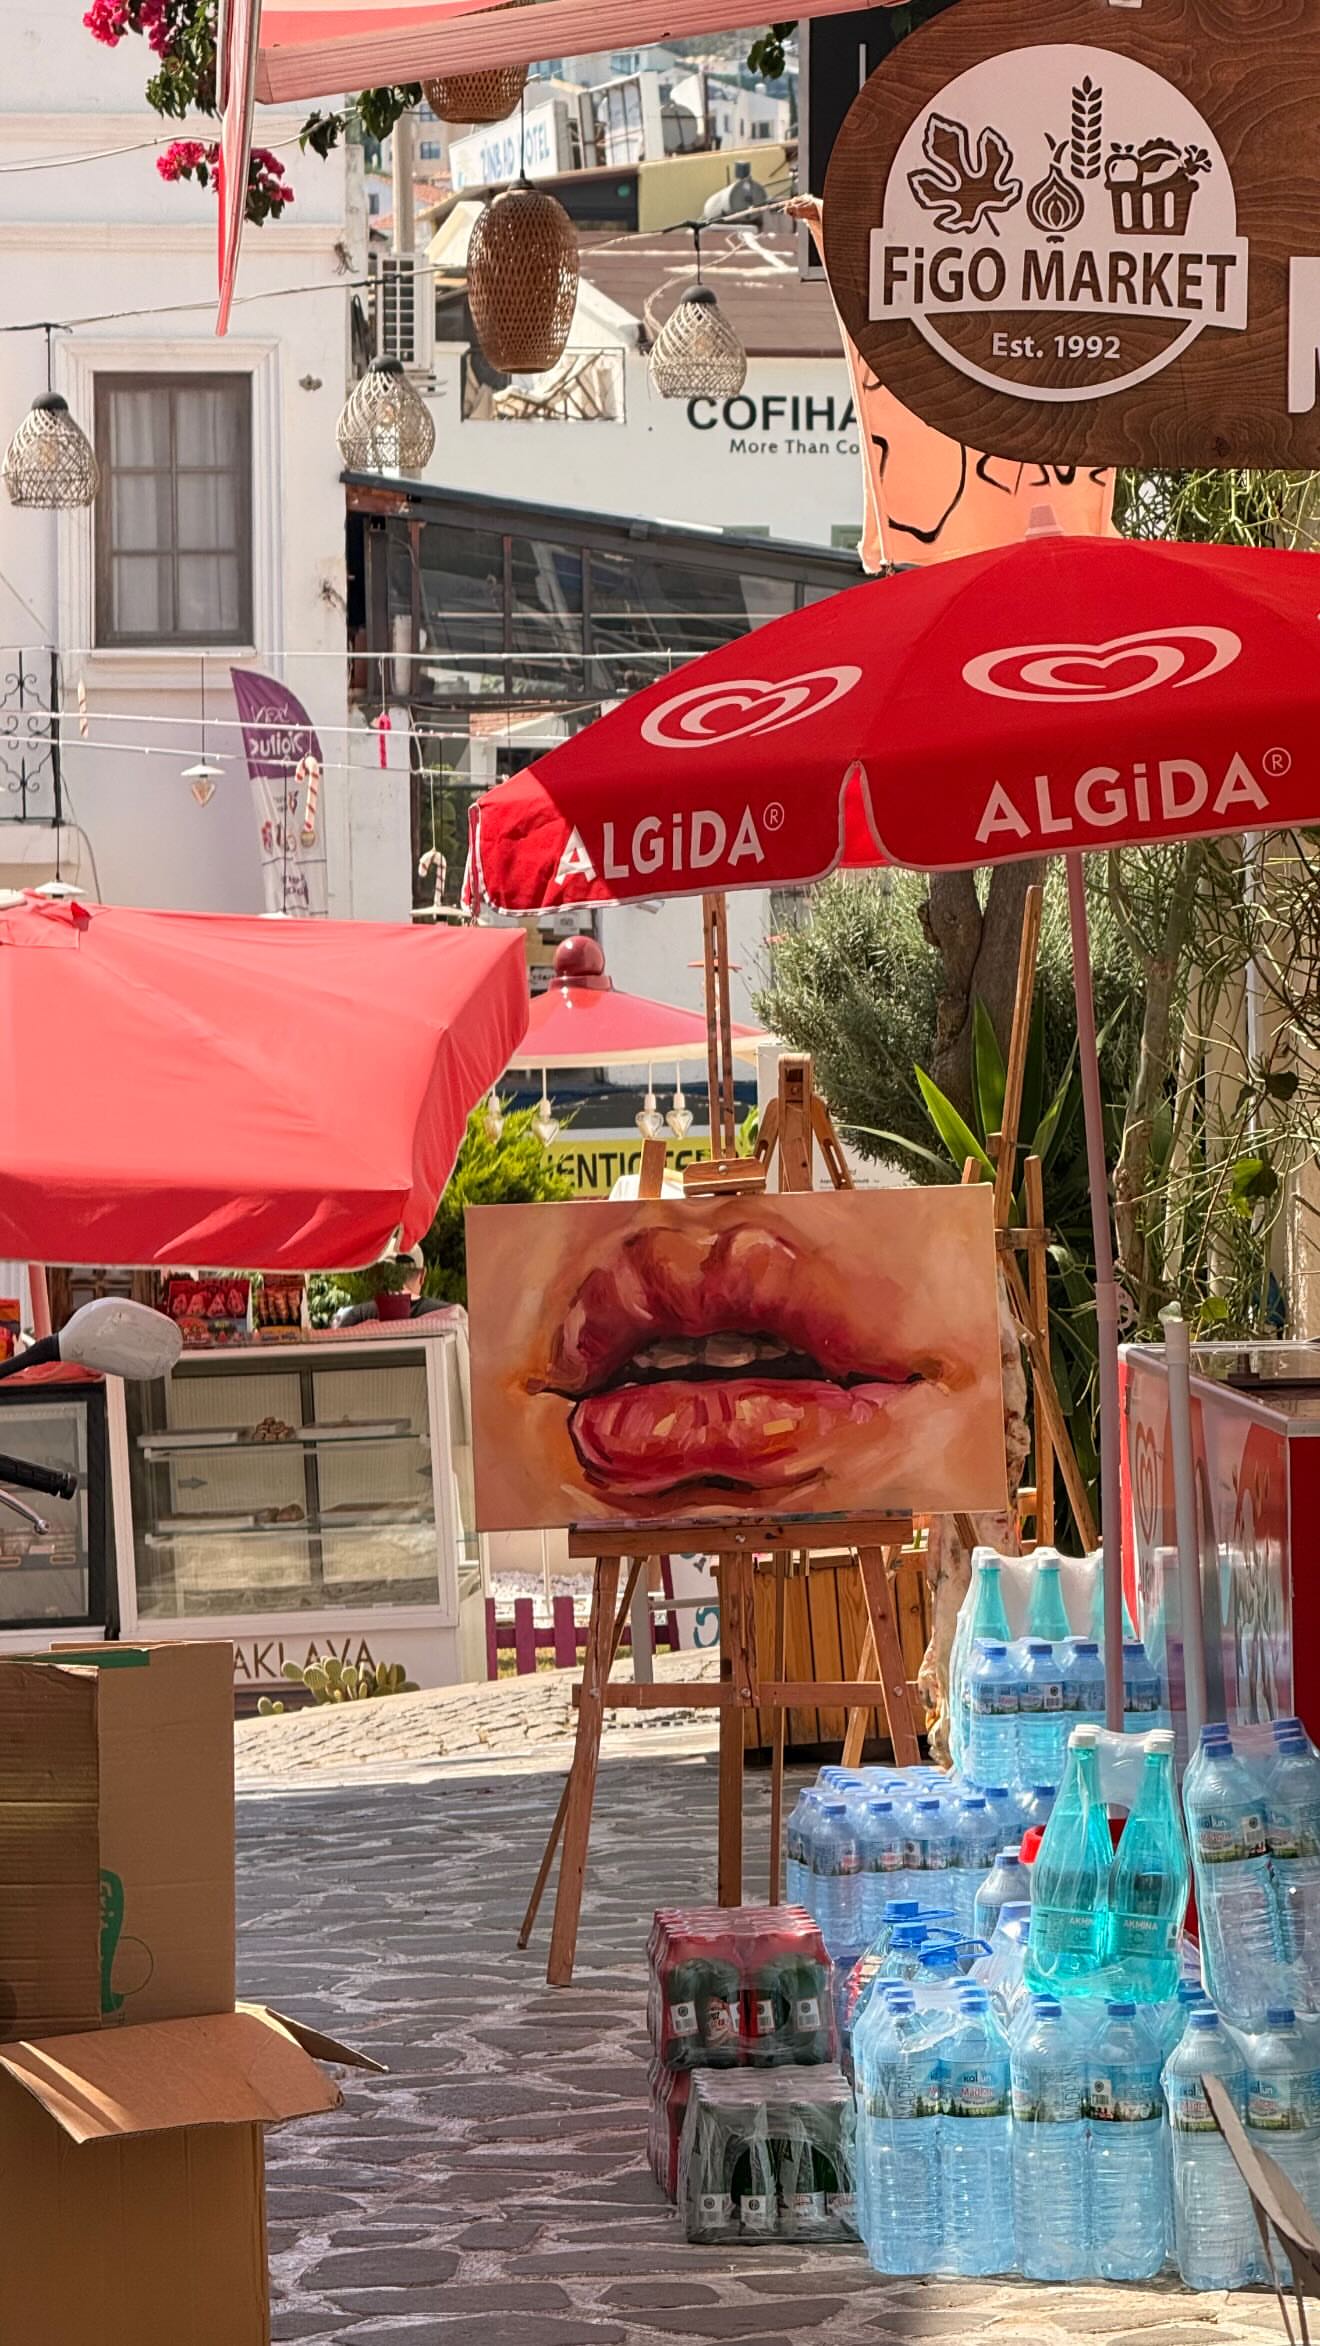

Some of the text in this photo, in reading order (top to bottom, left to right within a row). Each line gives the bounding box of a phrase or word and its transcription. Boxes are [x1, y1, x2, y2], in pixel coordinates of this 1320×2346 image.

[883, 245, 1237, 313] FiGO MARKET
[991, 333, 1122, 360] Est. 1992
[729, 439, 778, 454] More
[784, 439, 829, 454] Than
